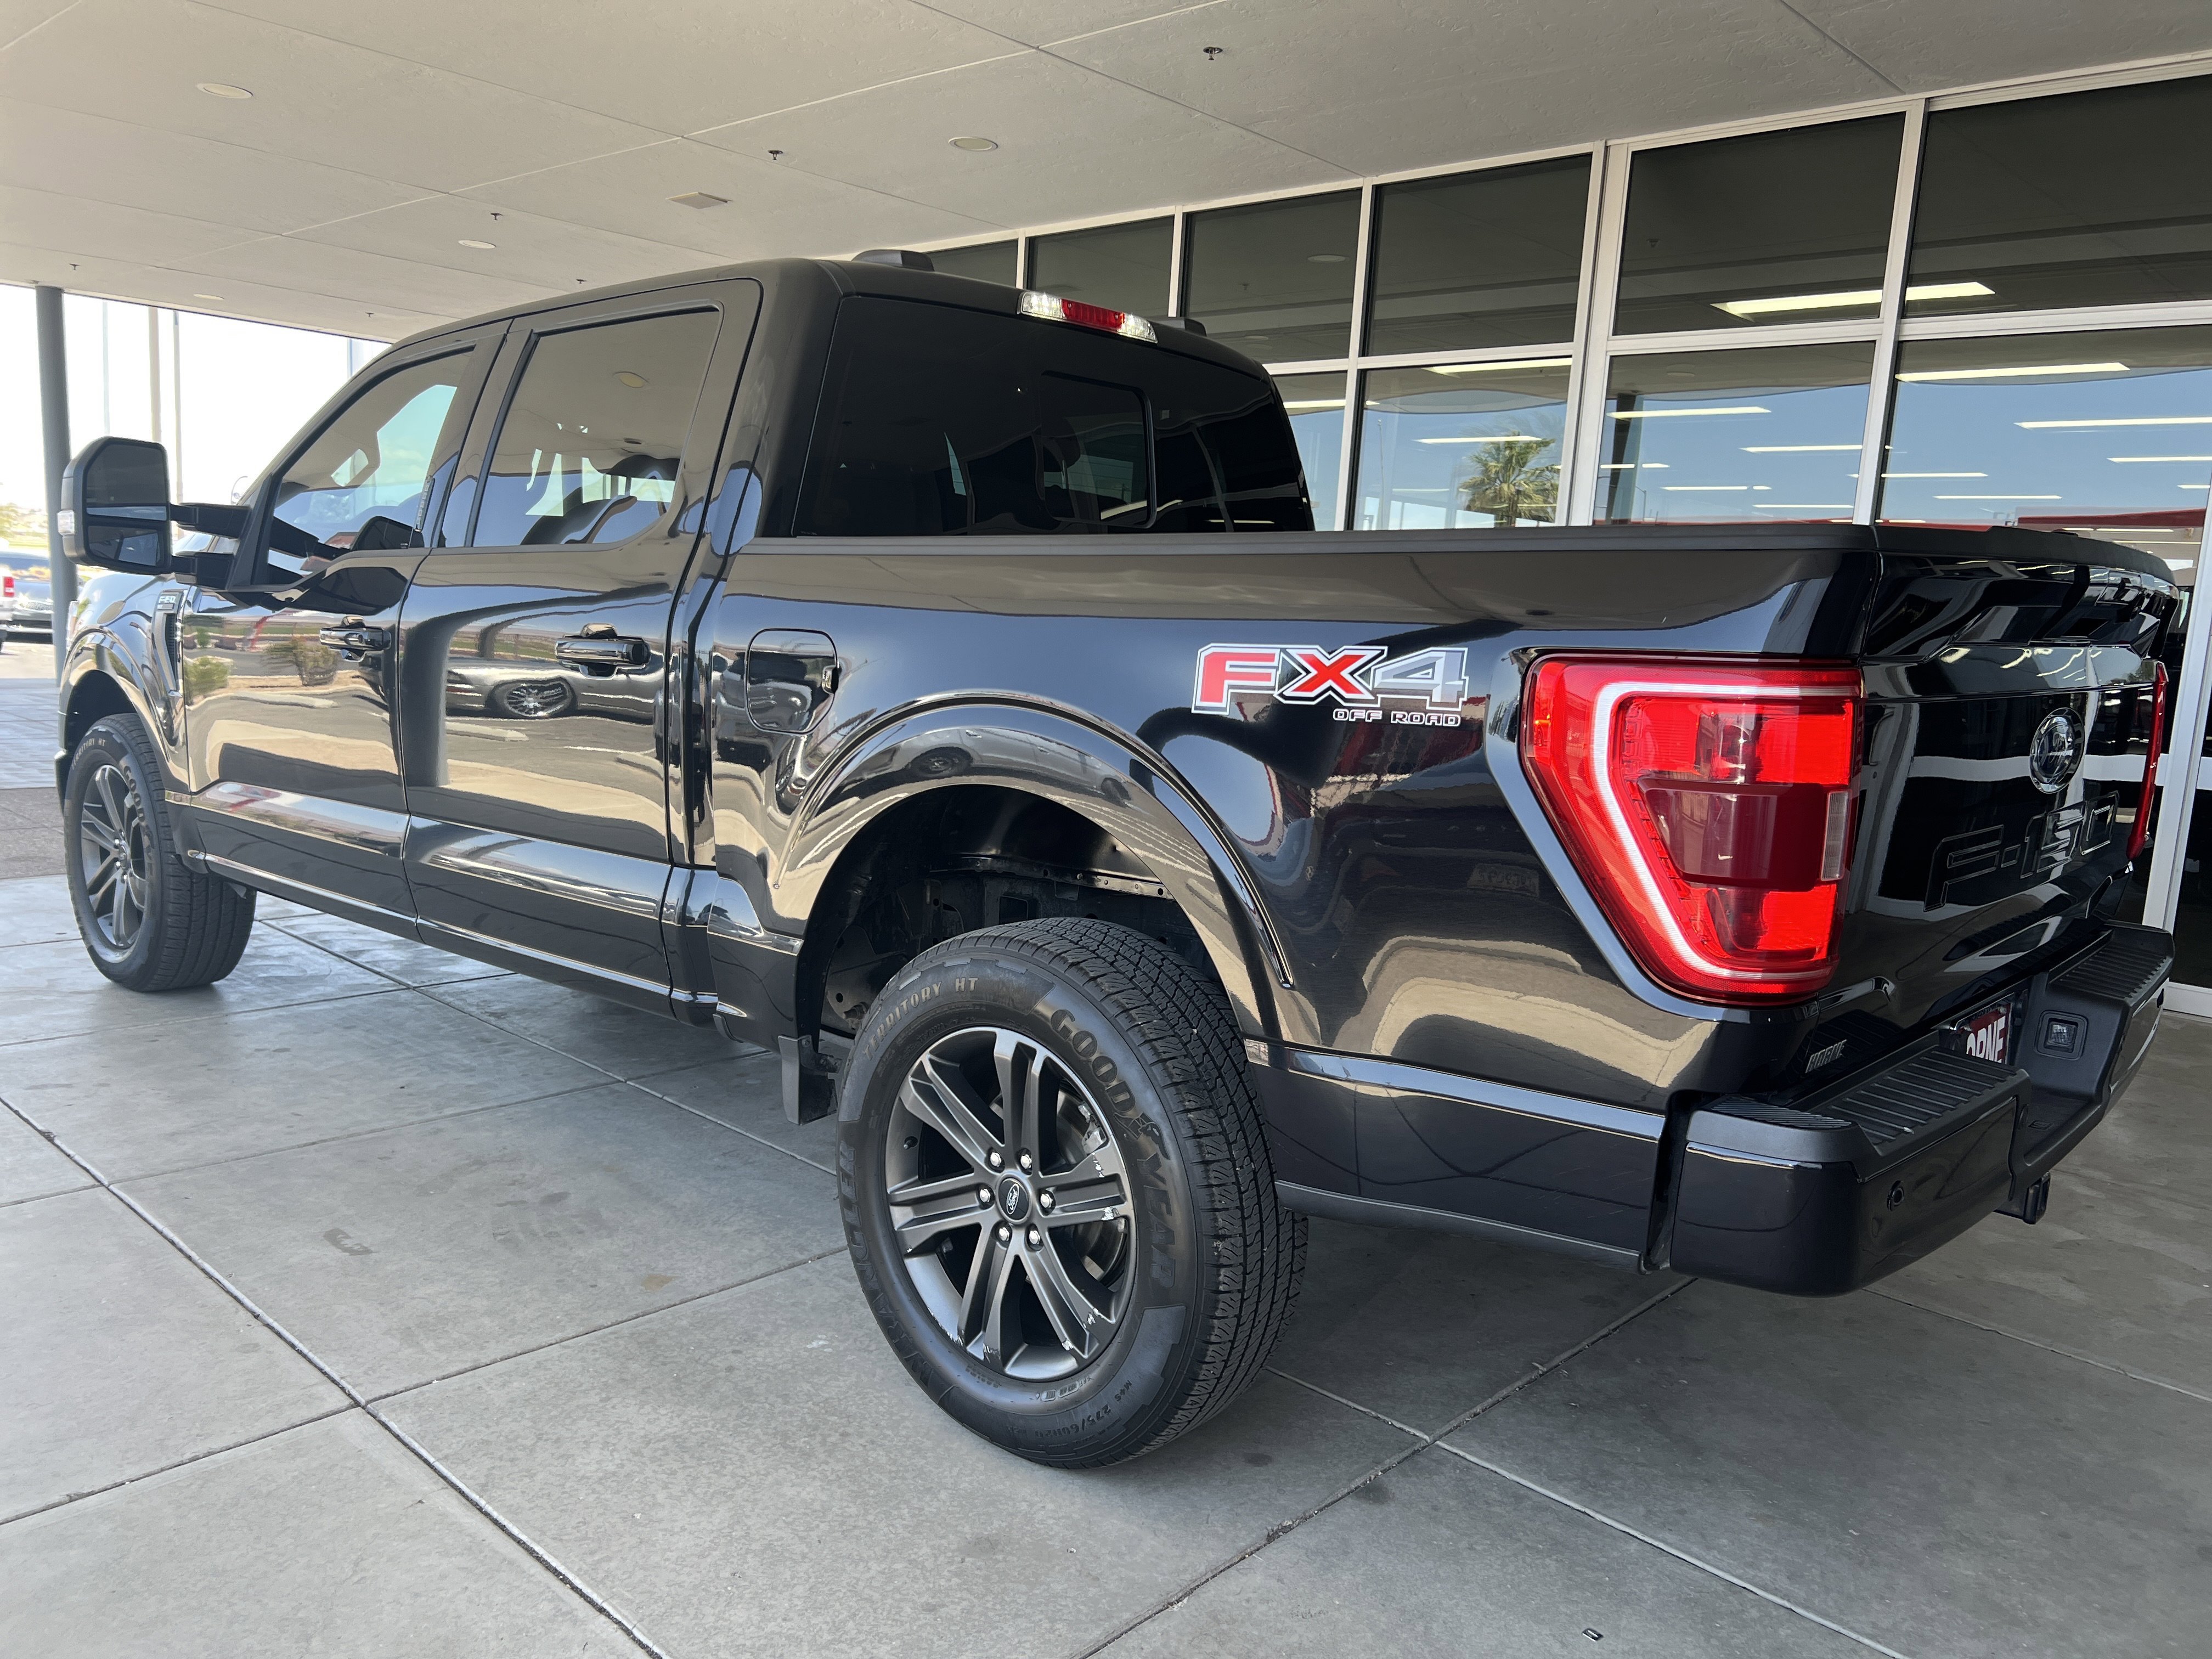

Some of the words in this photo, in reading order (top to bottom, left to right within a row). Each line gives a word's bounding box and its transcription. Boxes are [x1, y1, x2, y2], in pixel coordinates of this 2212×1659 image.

[1192, 642, 1469, 715] FX4
[98, 738, 106, 747] HT
[1333, 708, 1383, 723] OFF
[1390, 710, 1461, 727] ROAD
[1922, 790, 2120, 912] F-150
[862, 981, 942, 1060] TERRITORY
[955, 977, 979, 992] HT
[1966, 1015, 2006, 1064] ORNE
[1805, 1039, 1847, 1073] HORNE
[1050, 1009, 1176, 1288] GOODYEAR
[839, 1140, 933, 1388] WRANGLER
